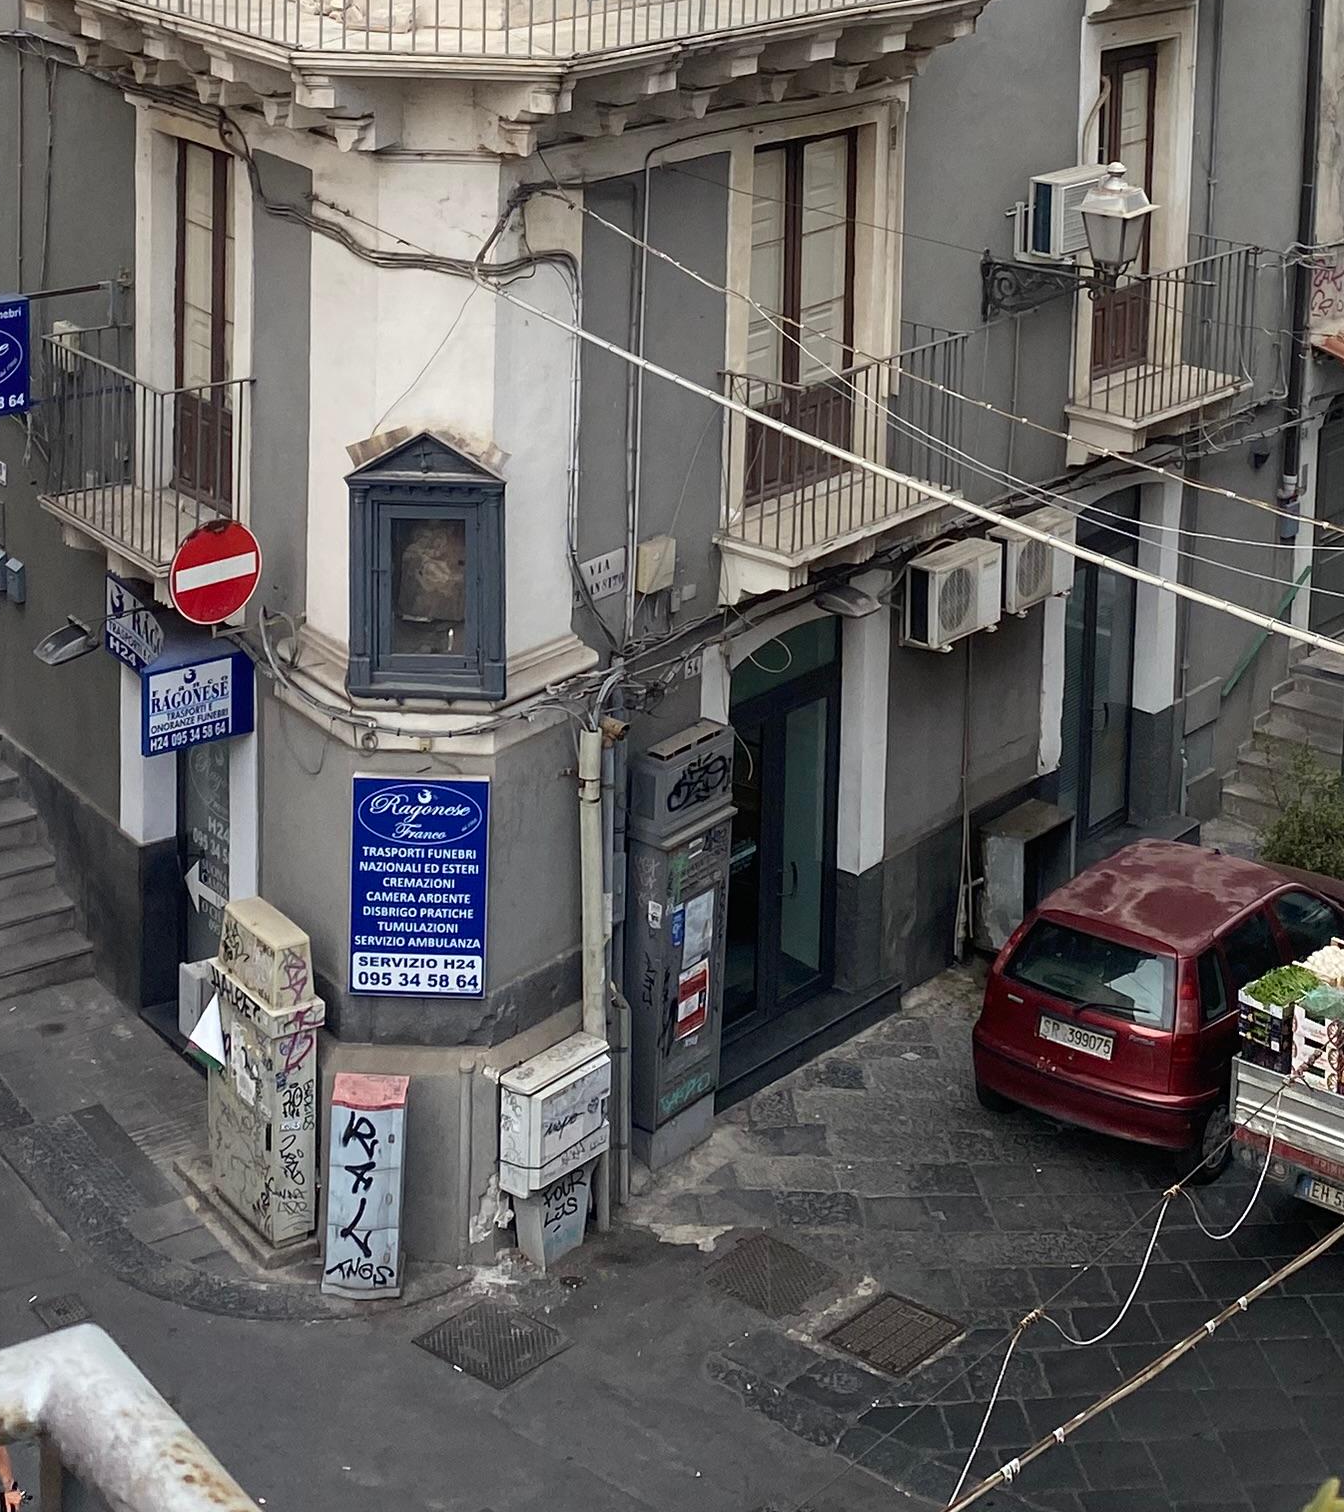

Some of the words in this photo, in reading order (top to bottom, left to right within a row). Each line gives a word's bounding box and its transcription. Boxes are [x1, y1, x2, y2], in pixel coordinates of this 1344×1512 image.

[8, 393, 25, 407] 64
[589, 559, 610, 576] VIA
[109, 635, 137, 667] H24
[151, 680, 229, 714] RAGONESE
[150, 717, 195, 734] ONORANZE
[197, 708, 229, 722] FUNEBRI
[166, 706, 207, 721] TRASPORTI
[150, 734, 169, 751] H24
[171, 730, 187, 746] 095
[189, 727, 201, 741] 34
[202, 724, 213, 737] 58
[215, 721, 226, 735] 64
[369, 792, 471, 824] Ragonese
[392, 822, 447, 840] Franco
[362, 846, 425, 859] TRASPORTI
[427, 848, 477, 860] FUNEBRI
[359, 861, 421, 874] NAZIONALI
[424, 863, 439, 874] ED
[442, 864, 479, 875] ESTERI
[382, 877, 455, 889] CREMAZIONI
[366, 891, 416, 903] CAMERA
[418, 892, 471, 904] ARDENTE
[362, 906, 417, 918] DISBRIGO
[420, 907, 474, 919] PRATICHE
[377, 921, 458, 933] TUMULAZIONI
[354, 935, 406, 947] SERVIZIO
[408, 936, 481, 949] AMBULANZA
[358, 956, 438, 969] SERVIZIO
[443, 959, 476, 970] H24
[358, 971, 392, 986] 095
[398, 973, 421, 987] 34
[427, 974, 450, 988] 58
[456, 975, 479, 989] 64
[1067, 1027, 1112, 1055] 399075
[1312, 1179, 1330, 1202] EH
